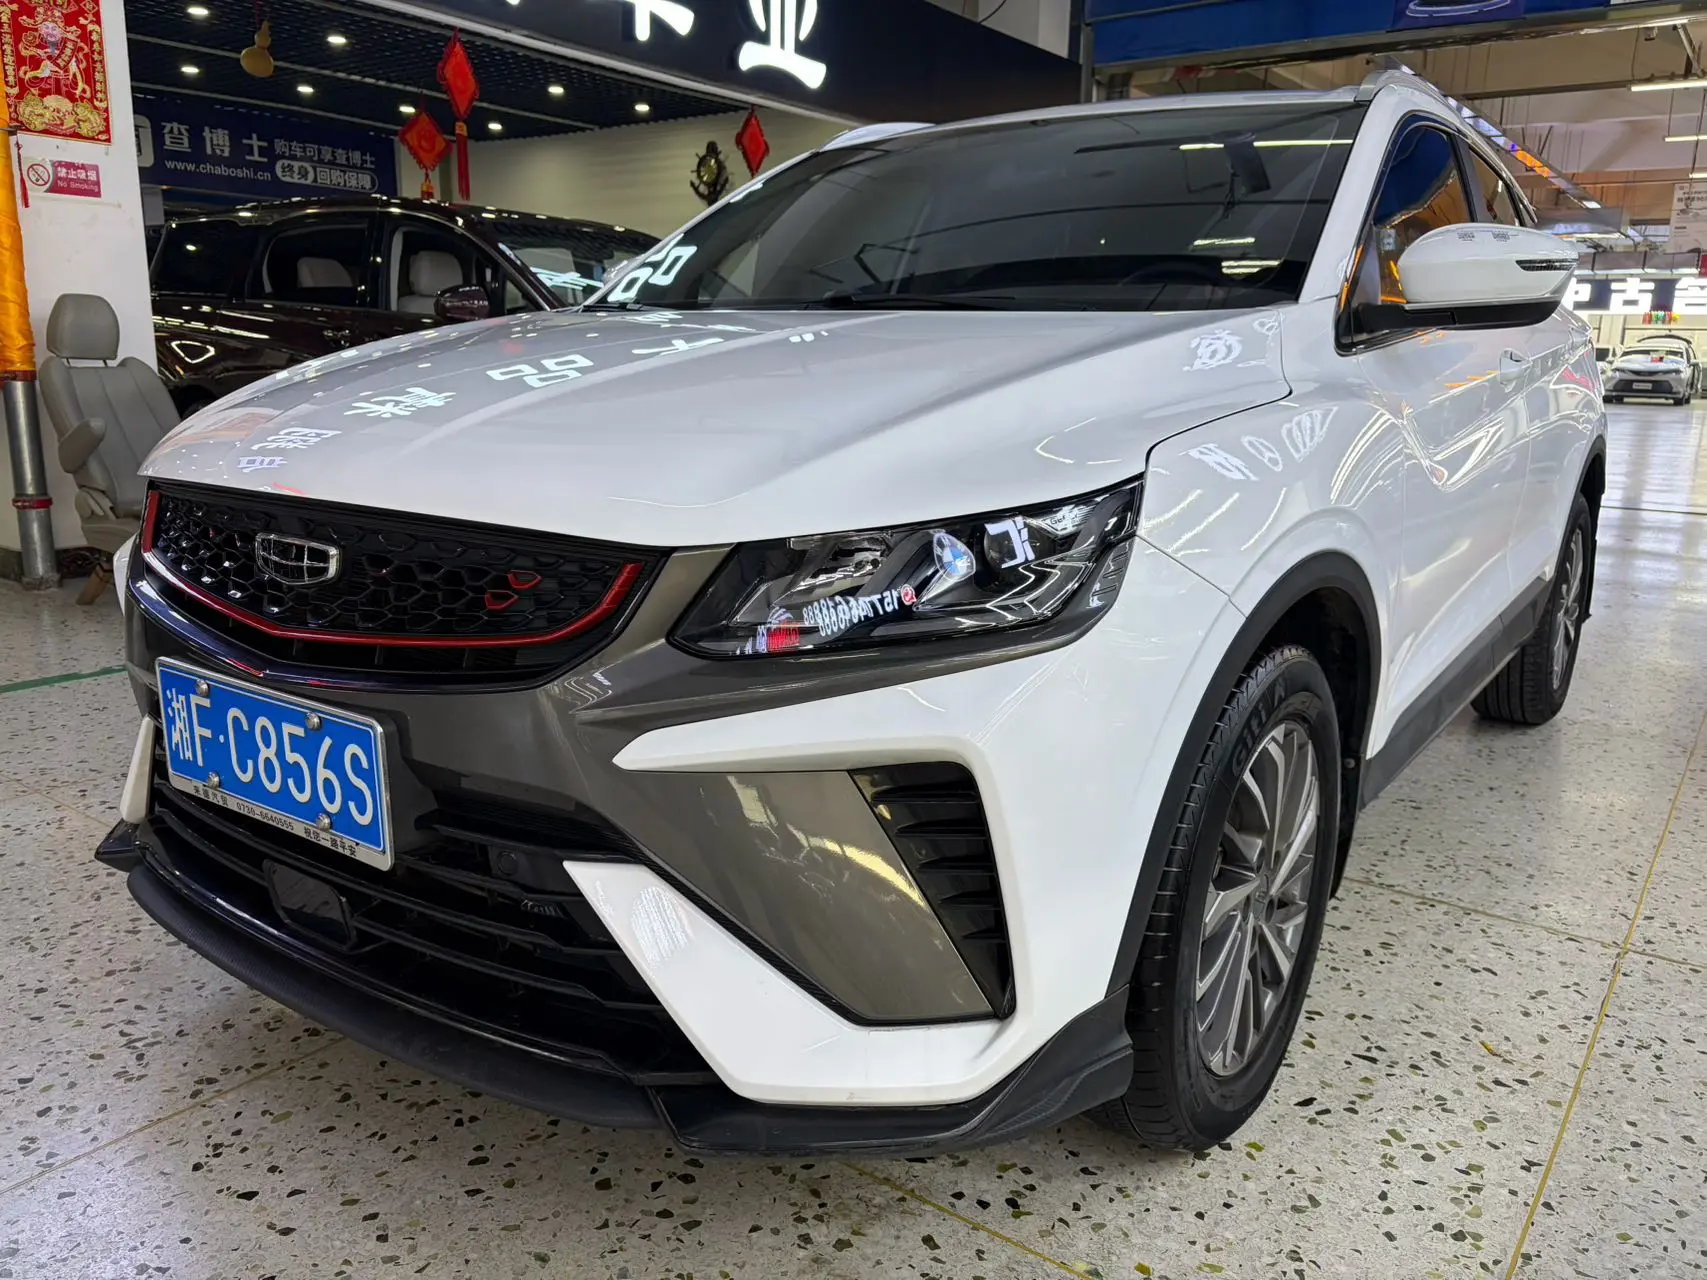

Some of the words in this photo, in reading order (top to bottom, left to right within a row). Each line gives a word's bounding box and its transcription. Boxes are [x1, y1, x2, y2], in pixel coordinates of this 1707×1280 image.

[161, 122, 268, 162] 查博士
[274, 138, 376, 168] 购车可享查博士
[165, 160, 271, 180] www.chaboshi.cn
[70, 182, 99, 192] Smoking
[236, 801, 295, 831] 0730-6640555
